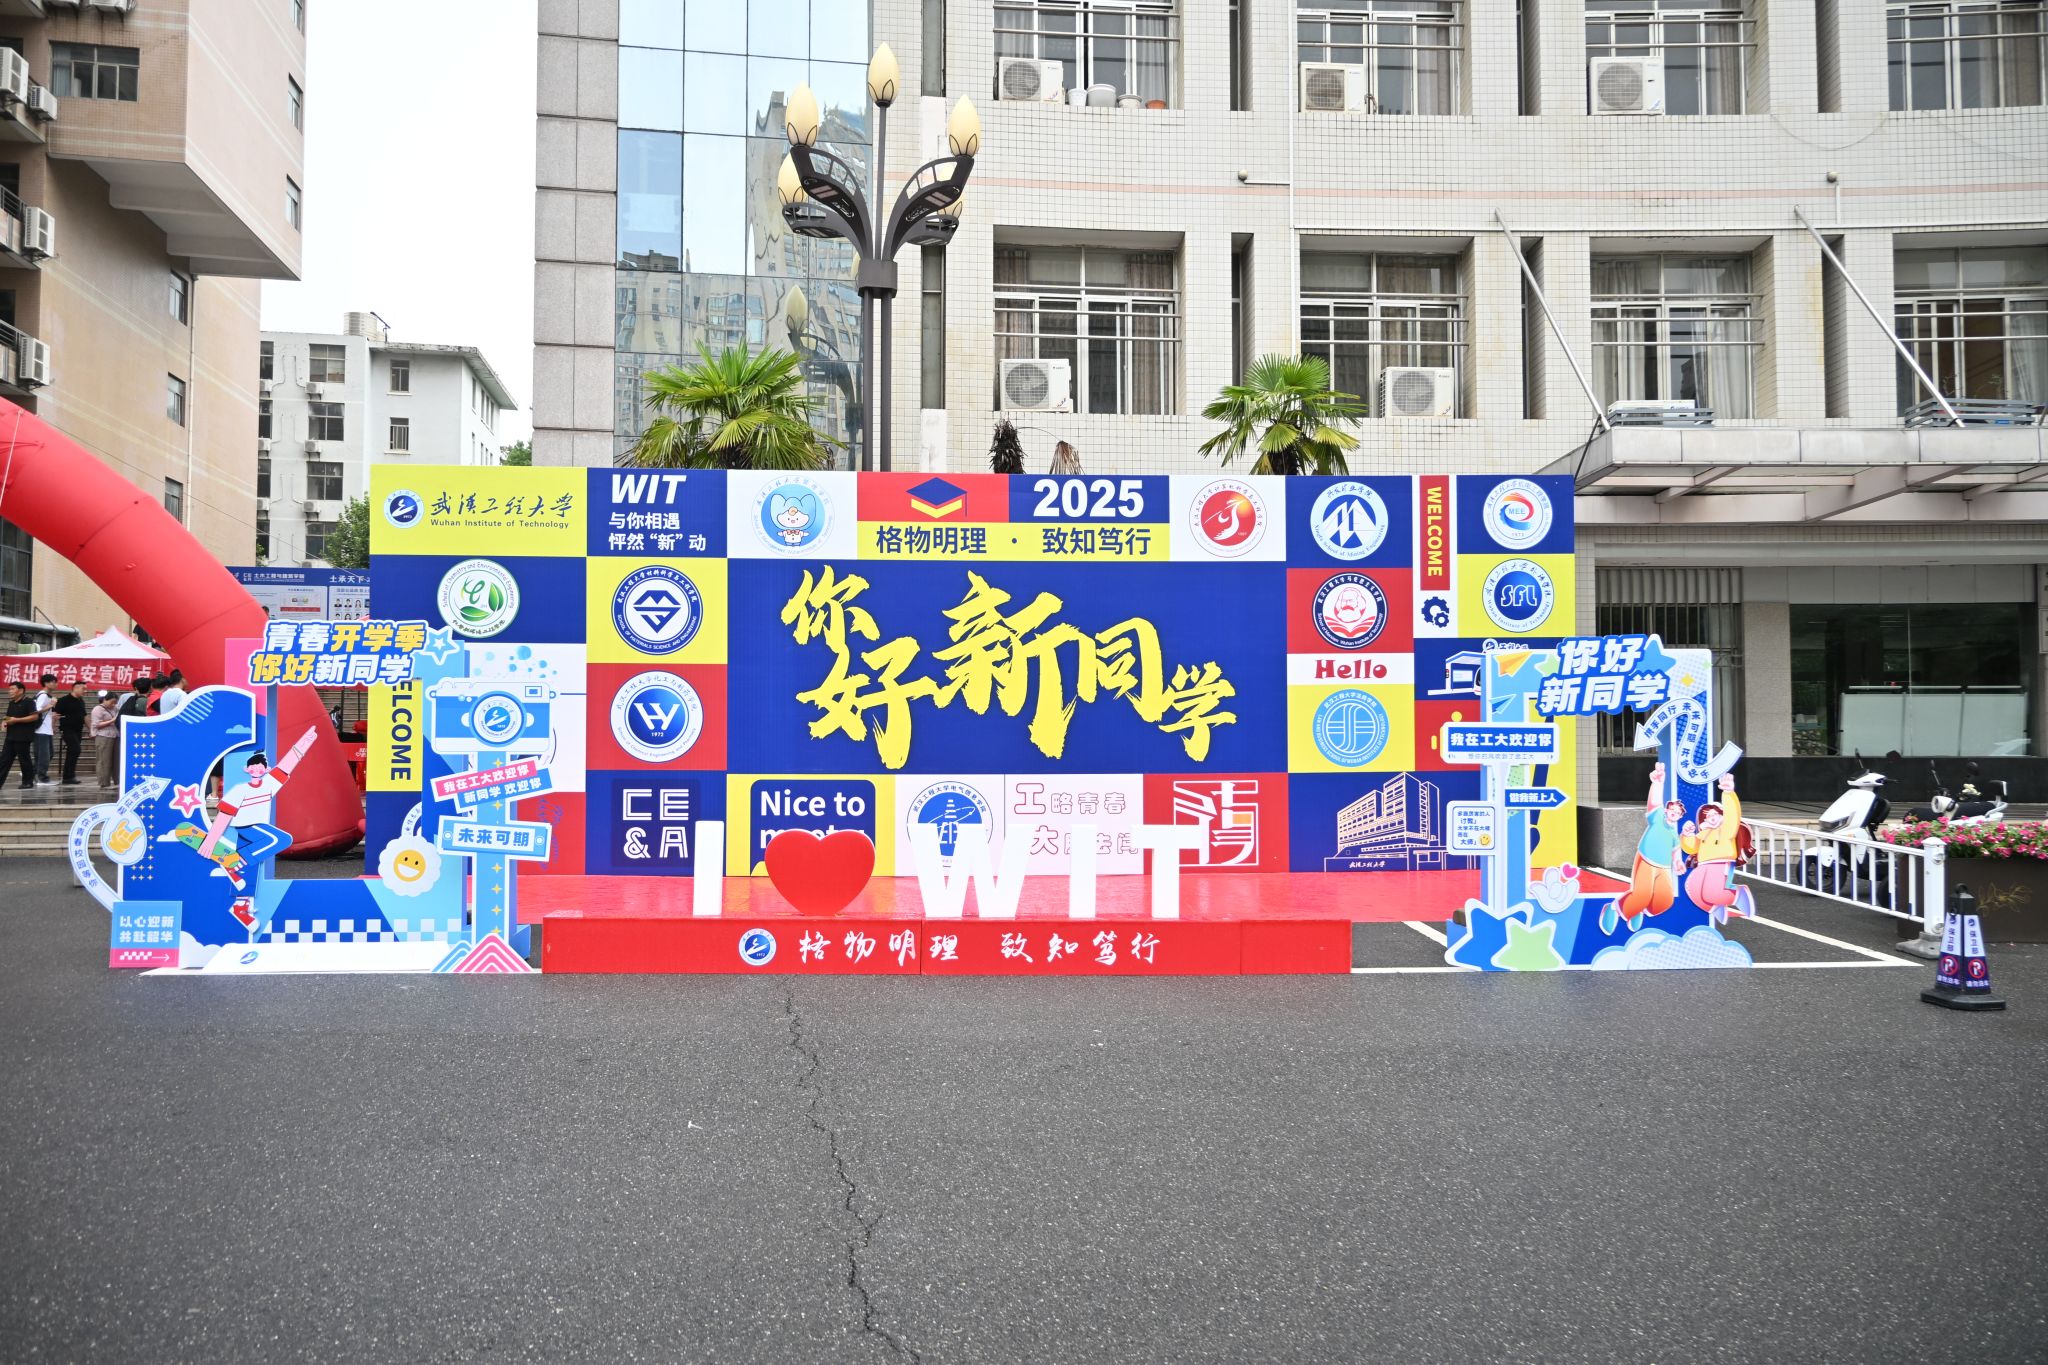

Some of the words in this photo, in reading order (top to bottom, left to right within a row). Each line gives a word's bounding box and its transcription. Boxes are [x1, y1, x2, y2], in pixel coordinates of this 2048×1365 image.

[611, 474, 687, 504] WIT
[1032, 479, 1146, 518] 2025
[431, 519, 461, 527] Wuhan
[464, 518, 502, 527] Institute
[506, 519, 515, 527] of
[519, 518, 570, 529] Technology
[608, 512, 681, 530] 与你相遇
[1426, 486, 1443, 577] WELCOME
[875, 527, 987, 555] 格物明理
[1041, 527, 1152, 555] 致知笃行
[1501, 585, 1537, 606] SFL
[266, 624, 427, 653] 青春开学季
[617, 613, 626, 630] SCHOOL
[628, 634, 652, 649] MATERIALS
[671, 638, 681, 646] AND
[679, 615, 697, 641] ENGINEERING
[251, 653, 412, 684] 你好新同学
[781, 565, 1237, 770] 你好新同学
[1315, 659, 1388, 680] Hello
[1561, 639, 1644, 676] 你好
[1540, 674, 1668, 714] 新同学
[391, 680, 412, 780] ELCOME
[1450, 732, 1552, 747] 我在工大欢迎你
[442, 764, 530, 793] 我在工大欢迎你
[463, 787, 502, 804] 新同学
[504, 777, 542, 798] 欢迎你
[622, 788, 689, 820] CE
[761, 789, 826, 817] Nice
[834, 792, 865, 816] to
[912, 783, 987, 813] 武汉工程大学电气信息学院
[458, 828, 530, 848] 未来可期
[623, 826, 689, 859] &A
[693, 821, 725, 917] I
[907, 823, 1203, 919] WIT
[120, 915, 174, 928] 以心迎新
[800, 929, 959, 966] 格物明理
[1001, 930, 1160, 966] 致知笃行
